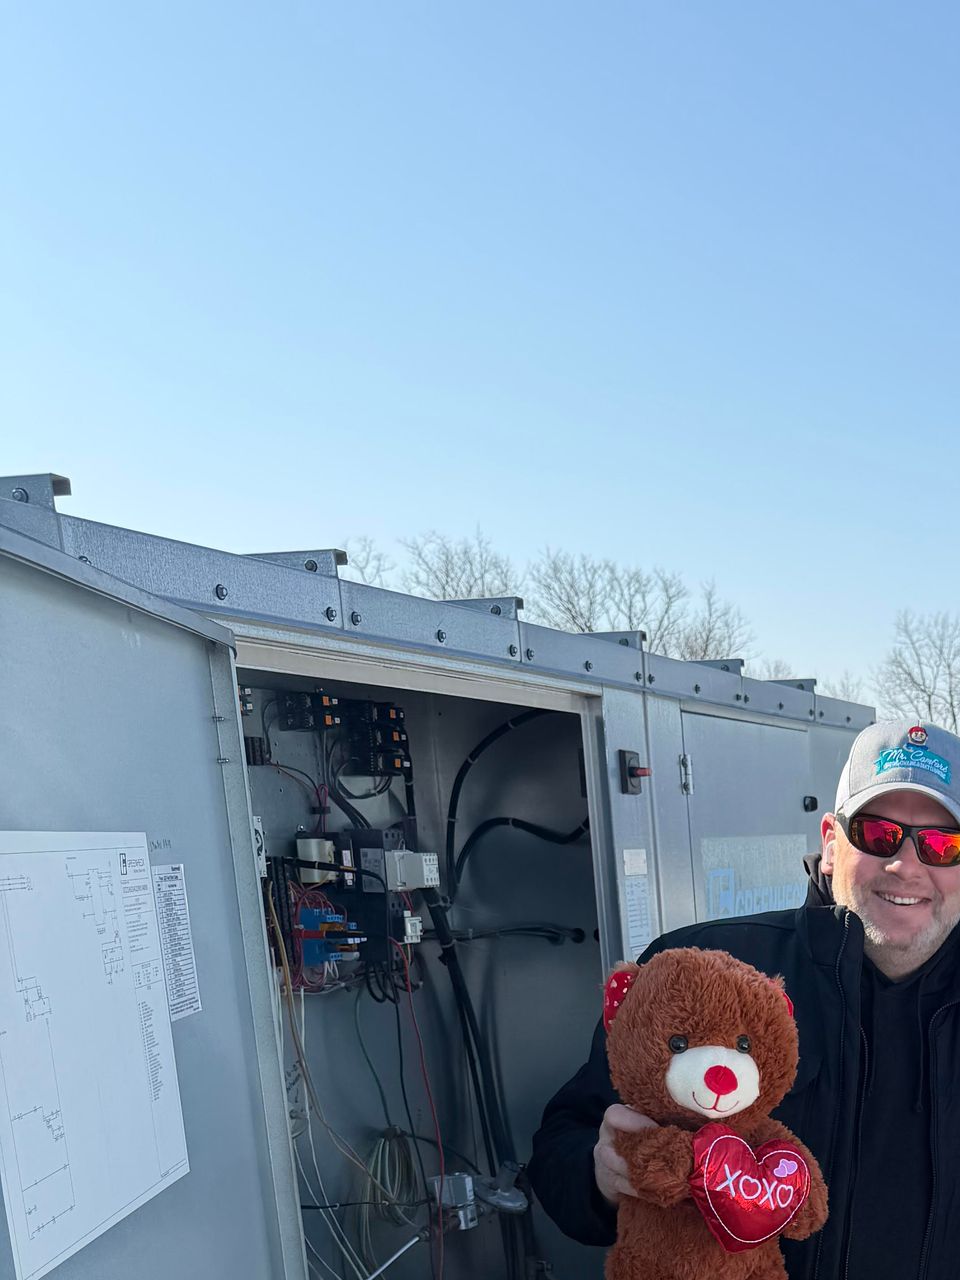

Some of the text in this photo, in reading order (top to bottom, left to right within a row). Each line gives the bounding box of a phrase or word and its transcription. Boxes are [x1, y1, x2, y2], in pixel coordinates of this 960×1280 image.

[882, 748, 907, 763] Mr.
[911, 750, 949, 773] Comfort
[715, 1163, 794, 1211] XOXO
